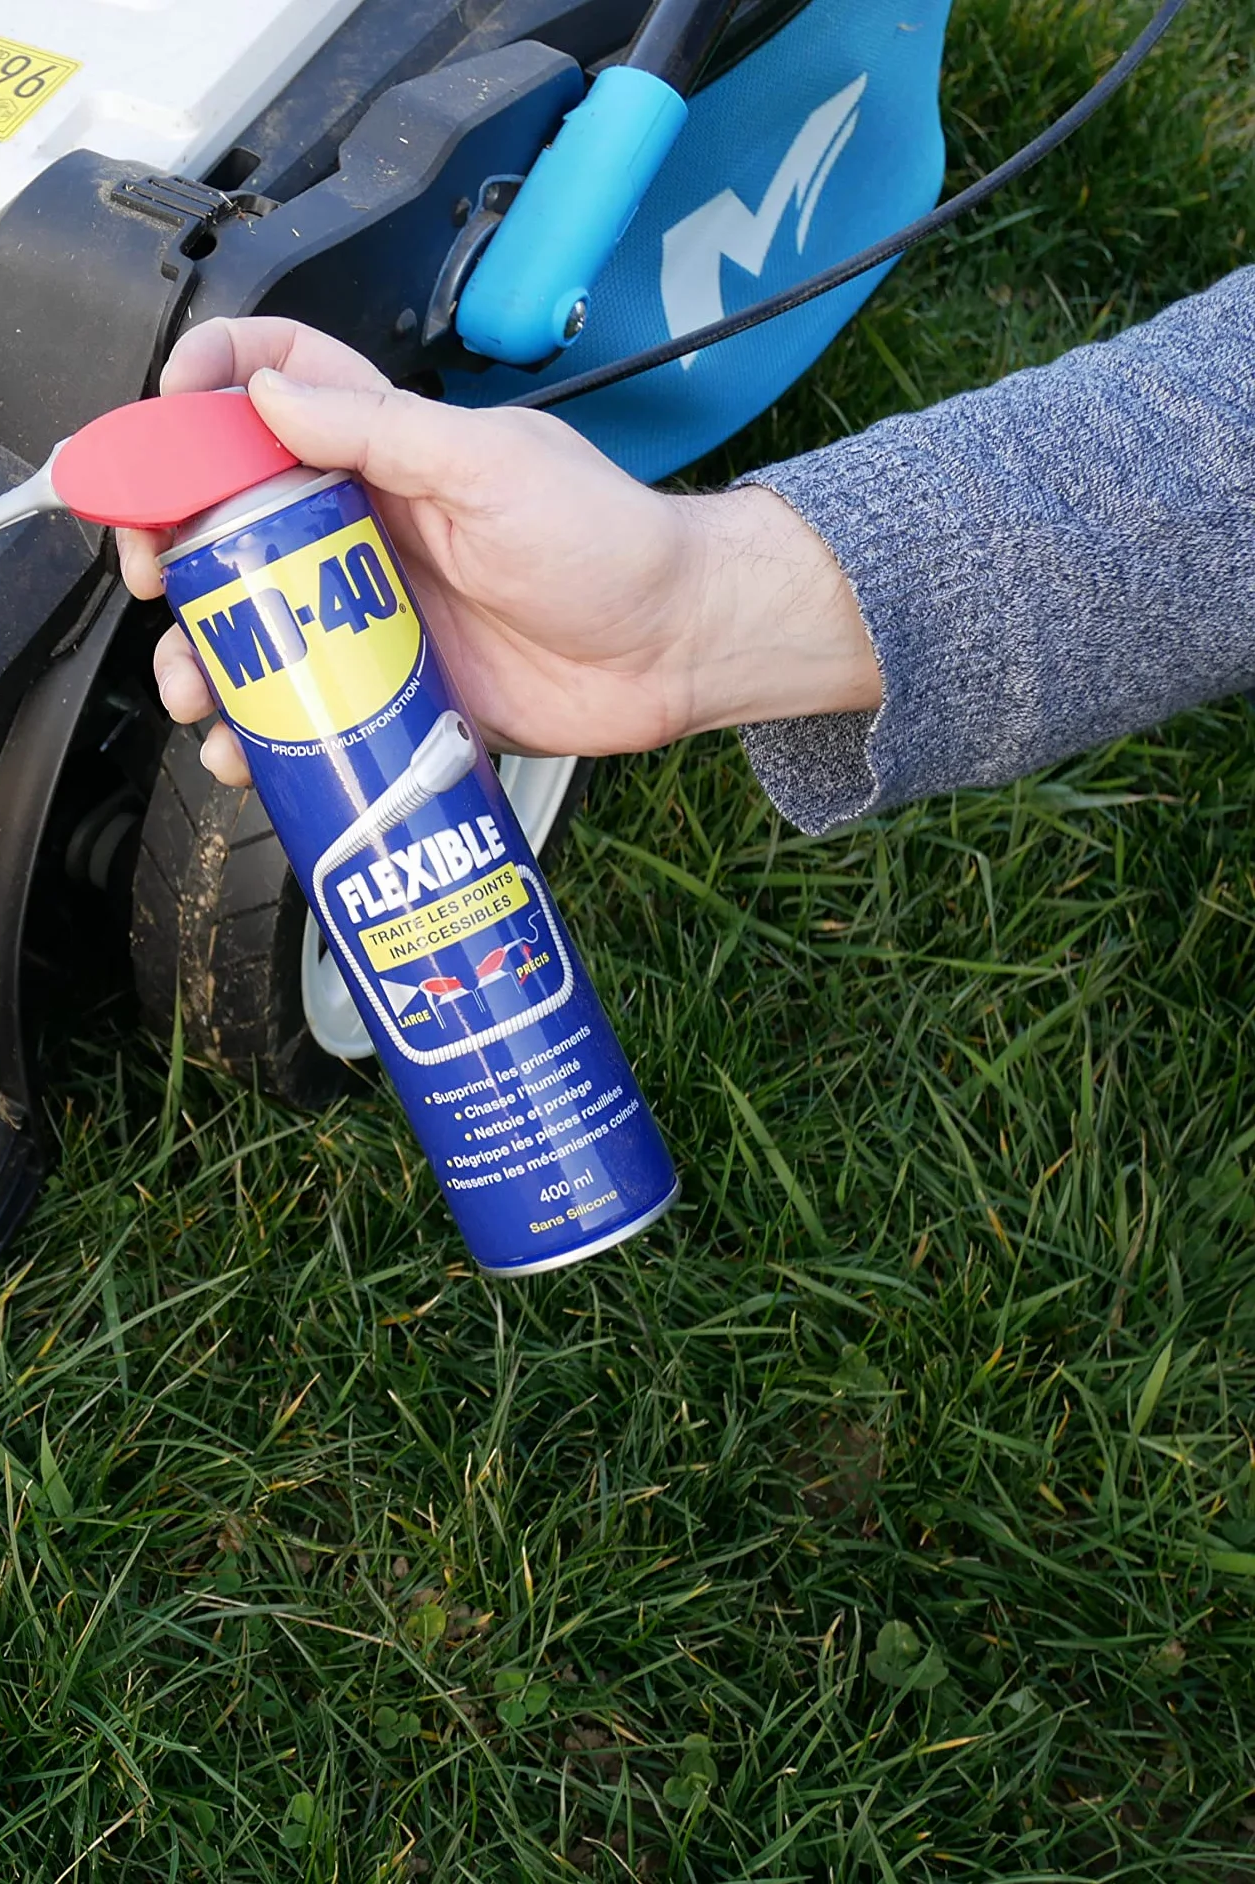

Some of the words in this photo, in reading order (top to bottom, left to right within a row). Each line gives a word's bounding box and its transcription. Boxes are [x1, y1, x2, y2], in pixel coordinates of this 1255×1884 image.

[271, 743, 327, 757] PRODUIT
[331, 677, 420, 751] MULTIFONCTION
[336, 815, 506, 924] FLEXIBLE
[368, 916, 425, 946] TRAITE
[427, 901, 459, 925] LES
[464, 871, 514, 907] POINTS
[389, 894, 512, 960] INACCESSIBLES
[397, 1009, 431, 1029] LARGE
[432, 1076, 495, 1106] Supprime
[495, 1067, 519, 1088] les
[520, 1024, 591, 1075] grincements
[452, 1143, 510, 1170] Dégrippe
[511, 1131, 534, 1152] les
[535, 1113, 581, 1143] pièces
[581, 1083, 624, 1119] rouillées
[464, 1092, 516, 1120] Chasse
[473, 1114, 525, 1141] Nettoie
[527, 1105, 542, 1121] et
[544, 1079, 593, 1119] protège
[451, 1171, 502, 1190] Desserre
[503, 1163, 525, 1180] les
[526, 1124, 609, 1172] mécanismes
[609, 1098, 640, 1130] coincés
[529, 1213, 565, 1234] Sans
[566, 1189, 619, 1221] Silicone
[539, 1181, 570, 1204] 400
[573, 1168, 594, 1190] ml
